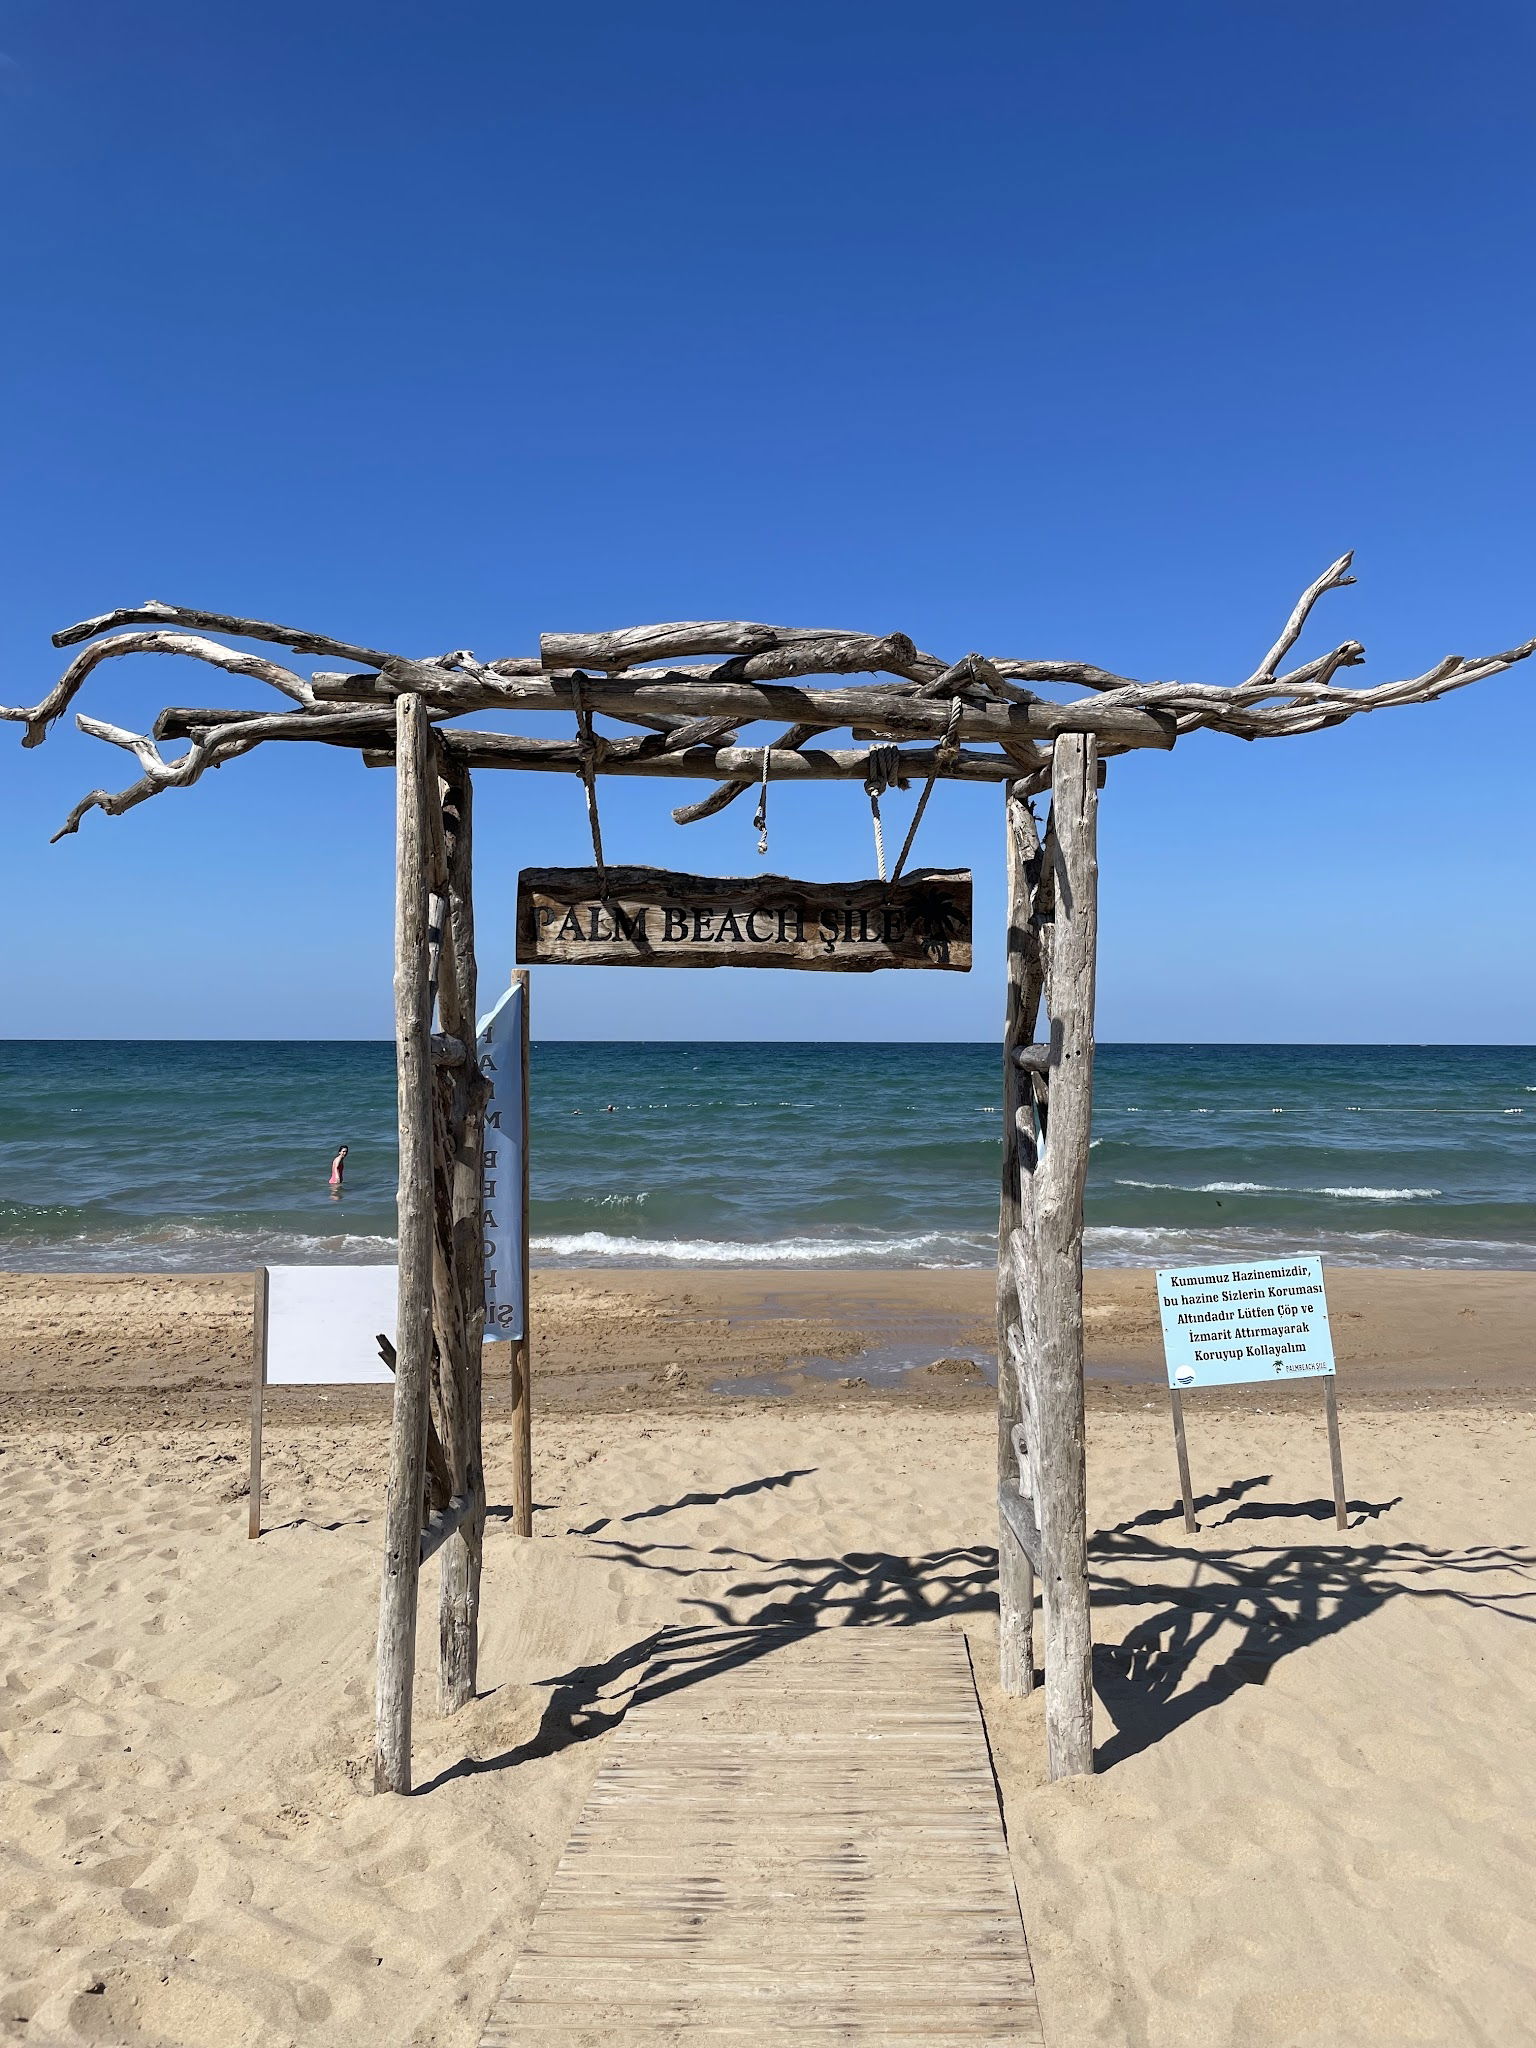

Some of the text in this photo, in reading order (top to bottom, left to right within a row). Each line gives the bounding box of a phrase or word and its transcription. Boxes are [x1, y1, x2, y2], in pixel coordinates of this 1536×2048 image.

[530, 905, 649, 942] PALM
[661, 905, 807, 943] BEACH
[1170, 1265, 1311, 1287] Kumumuz Hazinemizdir,
[1163, 1284, 1323, 1307] bu hazine Sizlerin Koruması
[1177, 1304, 1314, 1325] Altındadır Lütfen Çöp ve
[1189, 1322, 1310, 1343] İzmarit Attırmayarak
[1194, 1342, 1307, 1362] Koruyup Kollayalım
